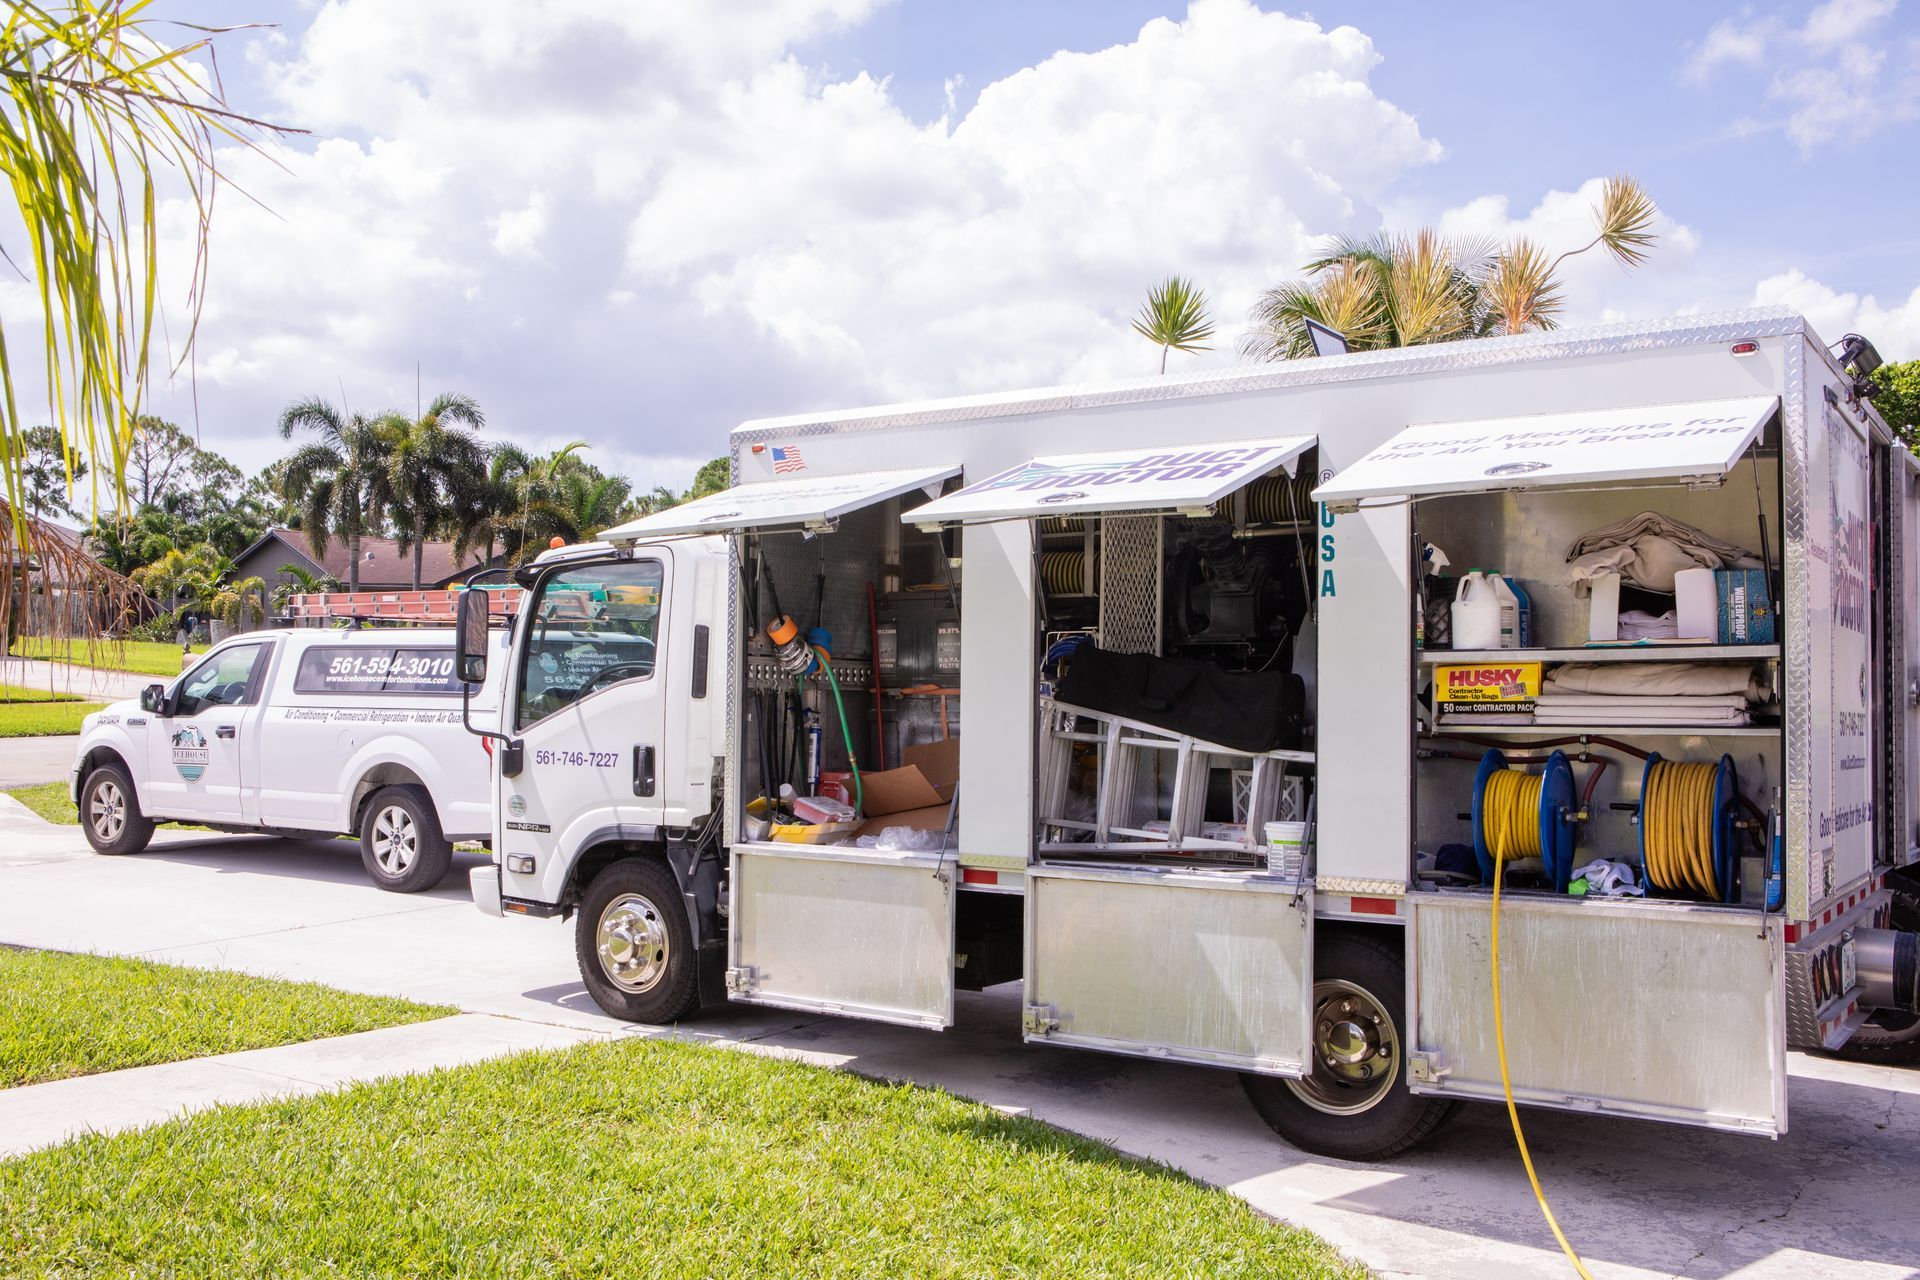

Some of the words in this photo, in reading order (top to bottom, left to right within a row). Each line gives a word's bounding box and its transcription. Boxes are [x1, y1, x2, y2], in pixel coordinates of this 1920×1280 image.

[1391, 435, 1490, 450] Good
[1494, 422, 1672, 442] Medicine
[1684, 415, 1748, 427] for
[1367, 450, 1425, 462] the
[1432, 445, 1492, 456] Air
[1502, 439, 1567, 451] You
[1577, 426, 1745, 445] Breathe
[1124, 445, 1283, 470] DUCT
[1016, 462, 1247, 491] DOCTOR
[1320, 500, 1336, 597] USA
[1734, 586, 1746, 640] WATERPROOF
[329, 656, 455, 676] 561-594-3010
[326, 674, 449, 685] www.icehousecomfortsolutions.com
[1448, 668, 1523, 687] HUSKY
[284, 709, 294, 719] Air
[294, 709, 329, 723] Conditioning
[333, 710, 369, 721] Commercial
[369, 710, 409, 725] Refrigeration
[414, 711, 436, 723] Indoor
[436, 712, 446, 723] Air
[1443, 703, 1455, 713] 50
[1473, 703, 1516, 712] CONTRACTOR
[1517, 703, 1535, 712] PACK
[174, 750, 207, 759] ICEHOUSE
[536, 750, 619, 768] 561-746-7227
